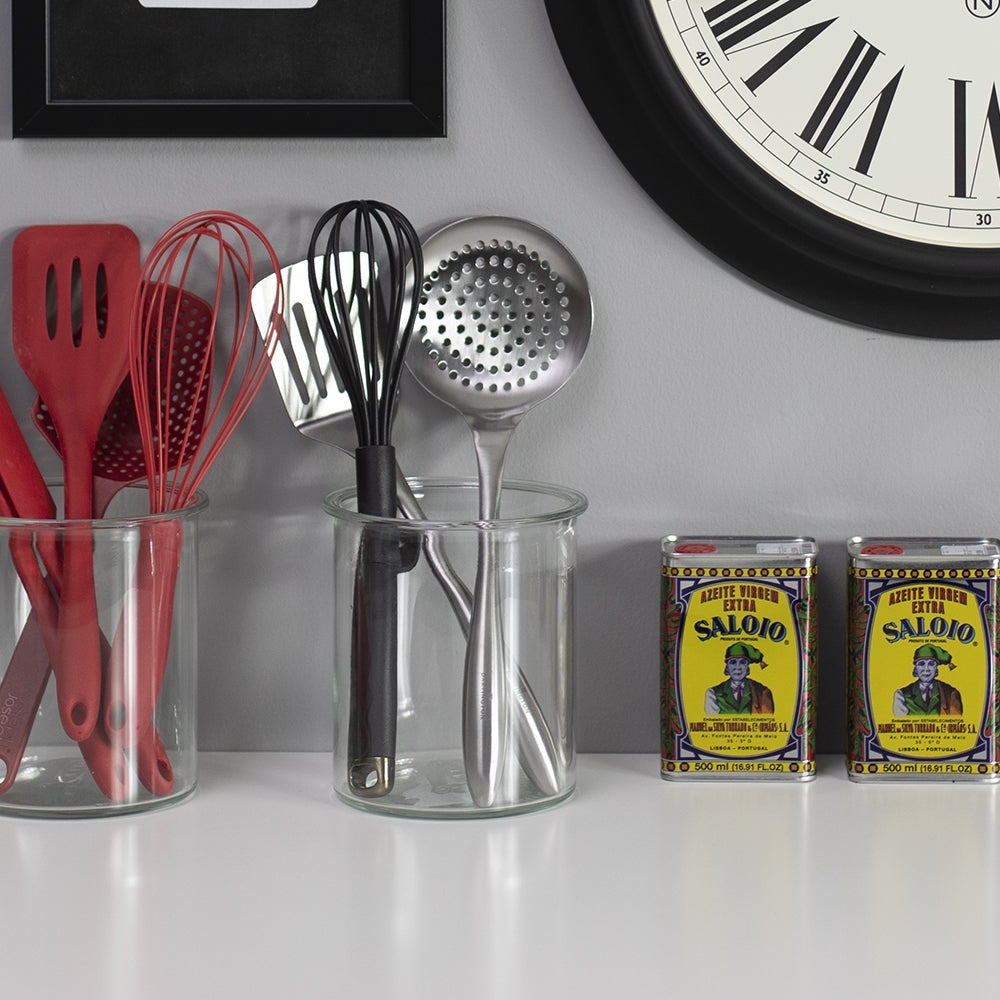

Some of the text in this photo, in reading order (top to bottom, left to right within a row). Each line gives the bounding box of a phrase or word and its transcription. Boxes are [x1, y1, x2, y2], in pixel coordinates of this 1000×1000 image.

[695, 51, 711, 67] 40
[794, 30, 905, 178] VII
[814, 170, 830, 184] 35
[976, 214, 992, 226] 30
[700, 586, 735, 604] AZEITE
[889, 587, 924, 606] AZEITE
[723, 599, 756, 612] EXTRA
[912, 601, 945, 614] EXTRA
[694, 615, 787, 642] SALOIO
[882, 617, 975, 644] SALOIO
[695, 762, 784, 772] 500 ml (16.91 FL.OZ)
[883, 764, 972, 773] 500 ml (16.91 FL.OZ)
